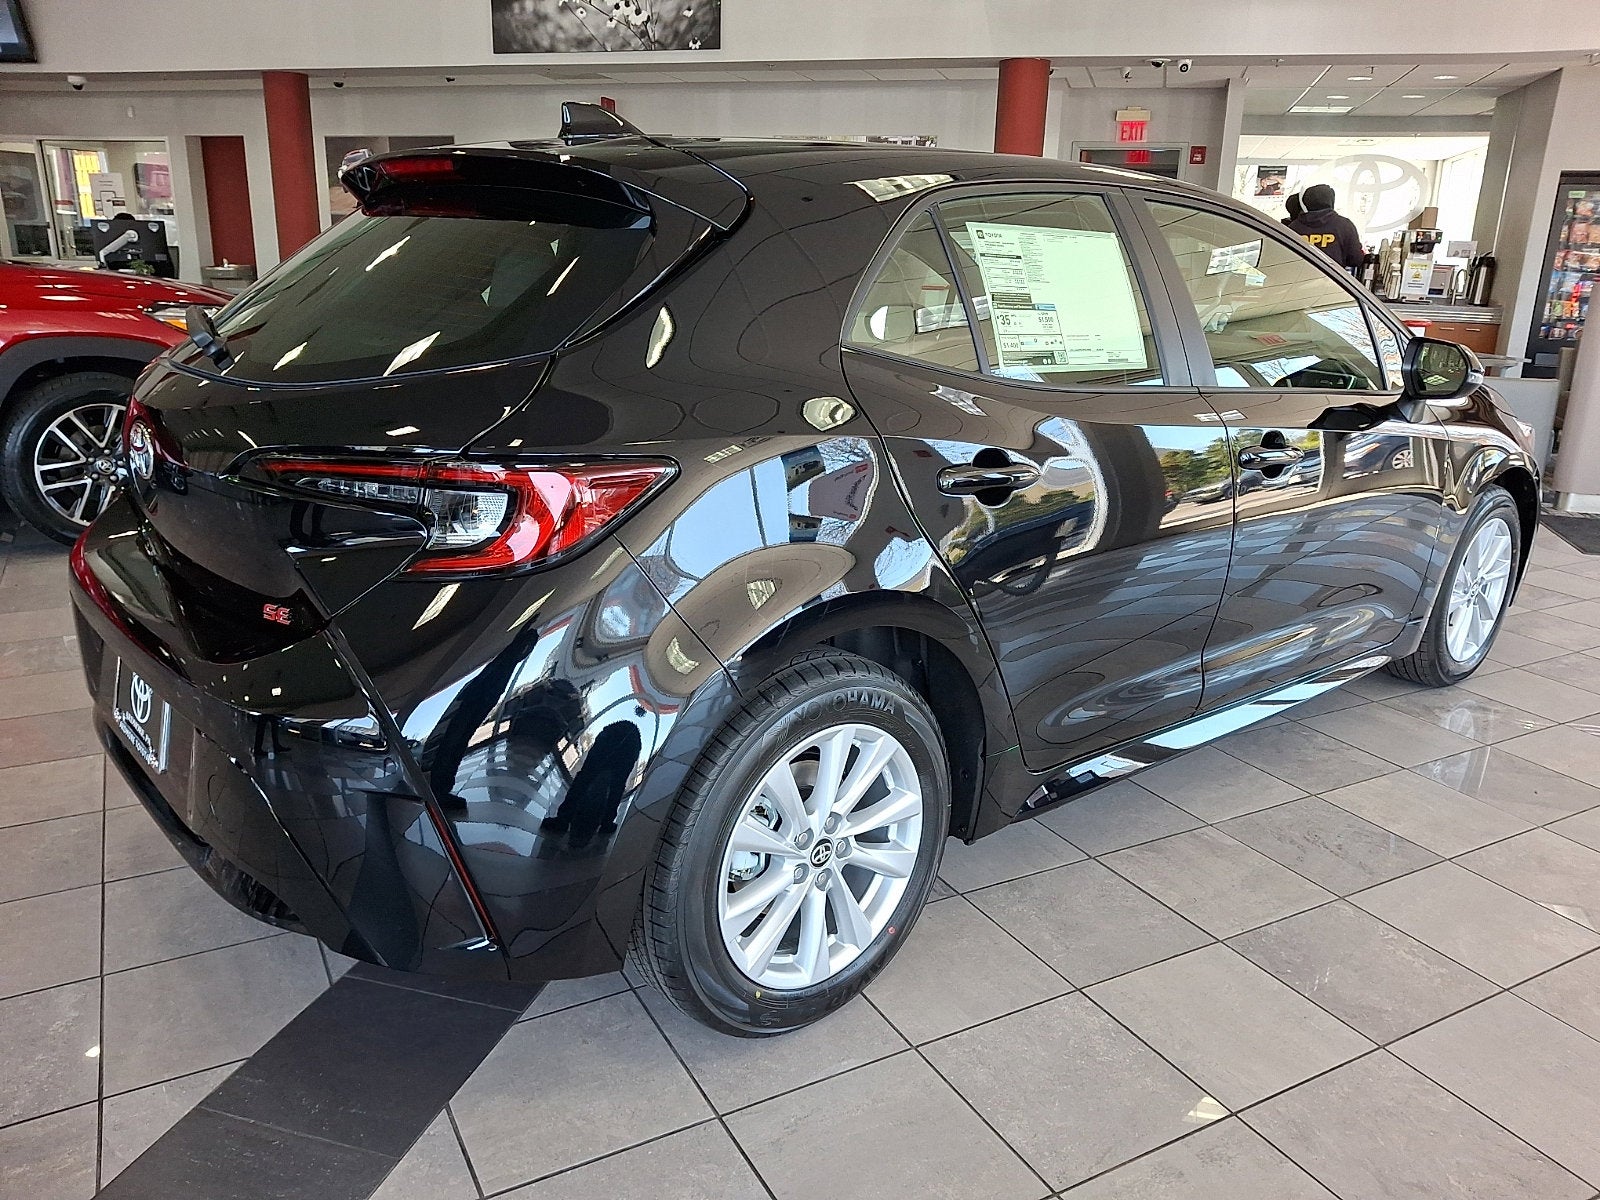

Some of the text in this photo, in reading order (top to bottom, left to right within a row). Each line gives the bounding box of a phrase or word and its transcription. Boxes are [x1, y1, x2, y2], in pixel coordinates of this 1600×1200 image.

[1121, 123, 1145, 141] EXIT
[999, 314, 1011, 326] 35
[263, 603, 291, 626] SE
